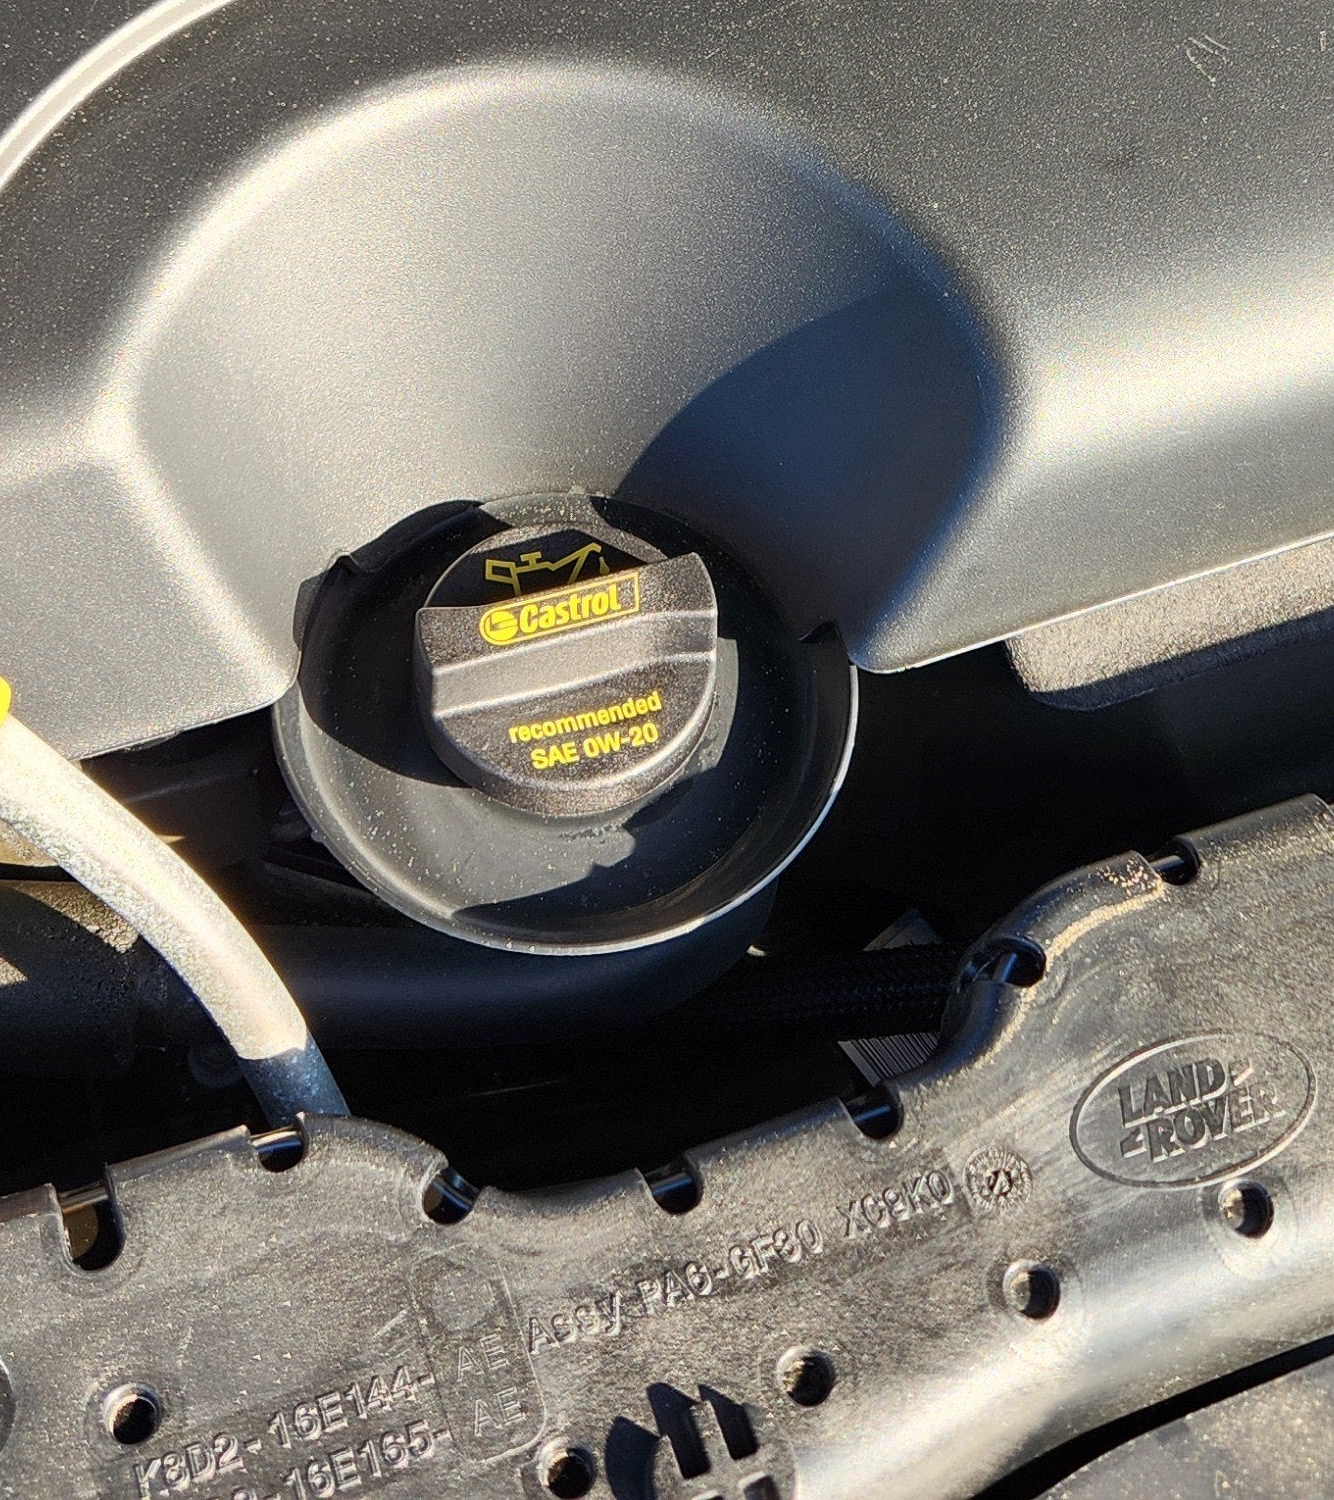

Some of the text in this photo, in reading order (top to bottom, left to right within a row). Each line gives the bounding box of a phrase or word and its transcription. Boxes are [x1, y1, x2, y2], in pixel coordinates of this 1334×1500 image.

[519, 583, 622, 635] Castrol
[508, 690, 662, 744] recommended
[530, 722, 659, 772] SAE 0W-20
[1117, 1057, 1227, 1129] LAND
[1147, 1078, 1288, 1164] ROVER
[455, 1330, 511, 1384] AE
[473, 1389, 527, 1438] AE
